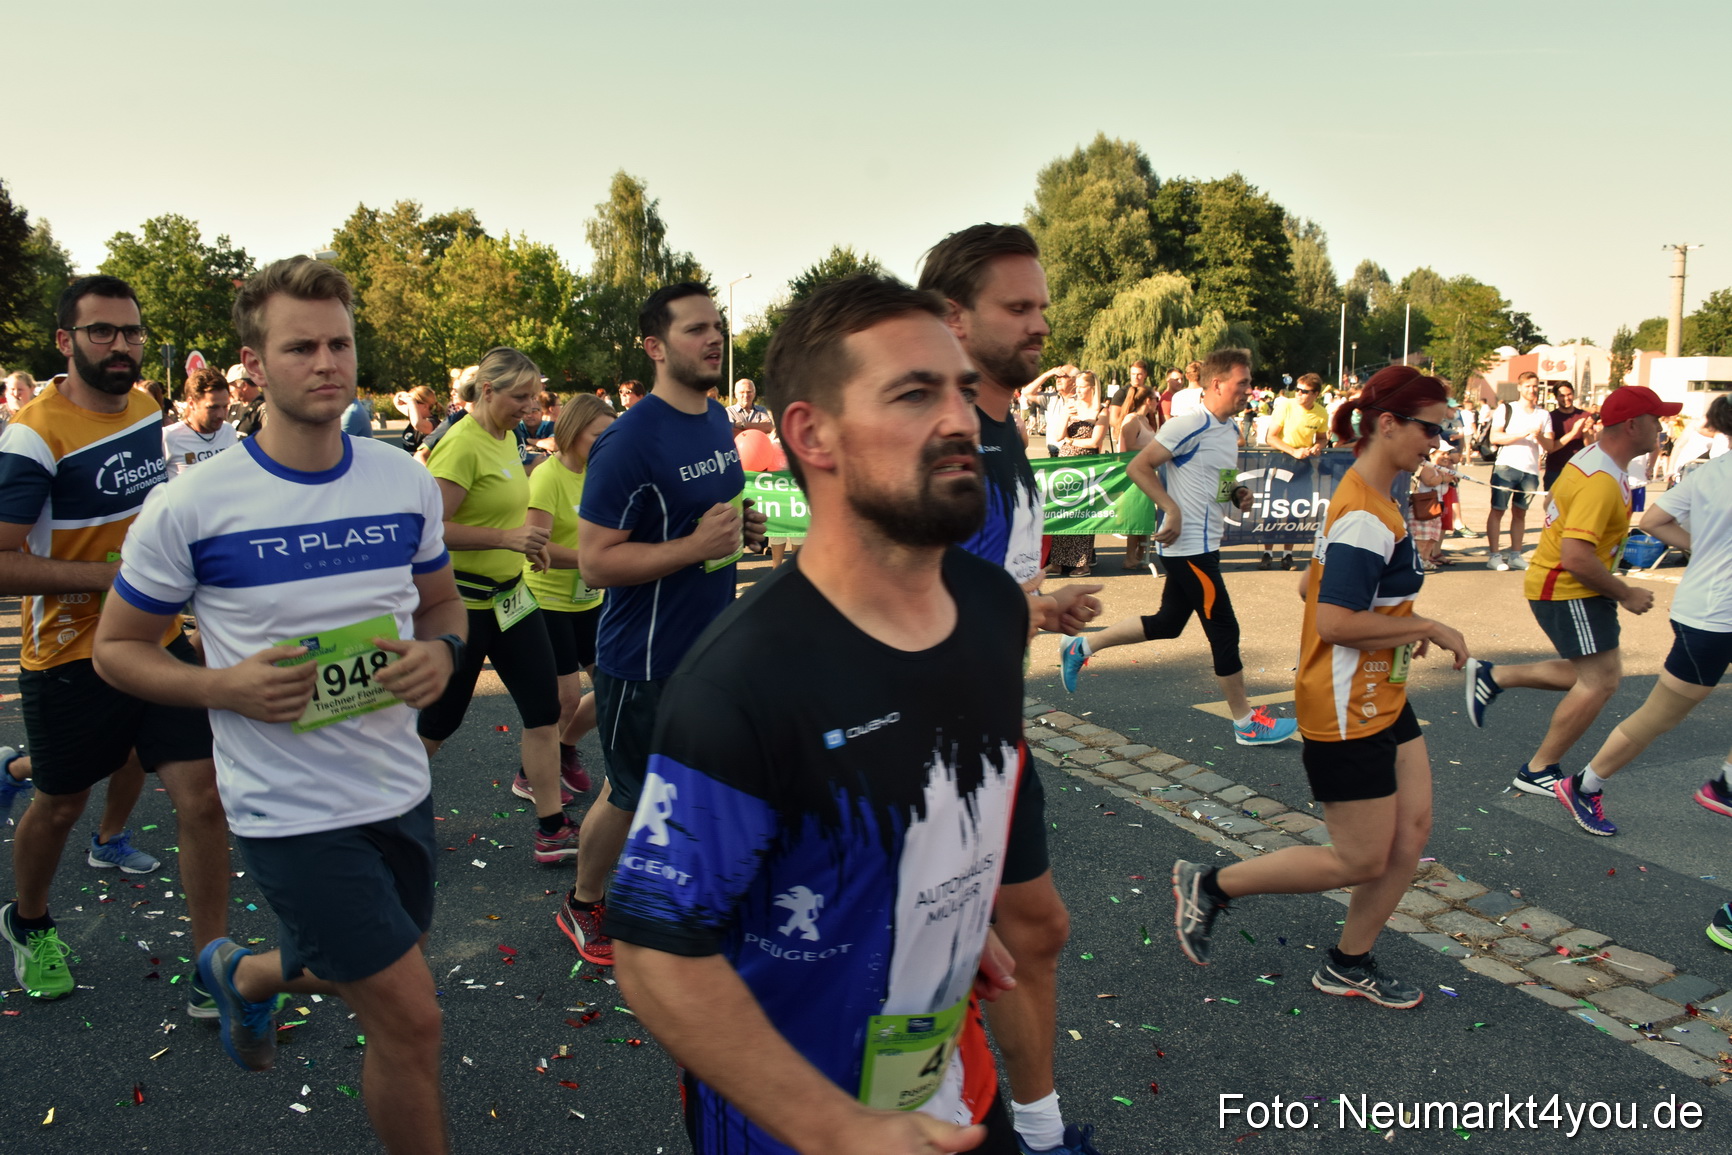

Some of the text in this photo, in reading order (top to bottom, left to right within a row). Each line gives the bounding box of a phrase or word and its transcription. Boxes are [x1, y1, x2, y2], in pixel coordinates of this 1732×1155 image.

[679, 458, 718, 482] EURO
[249, 523, 400, 559] TR PLAST
[303, 554, 370, 570] GROUP
[617, 855, 694, 886] GEOT
[743, 932, 854, 962] PEUGEOT
